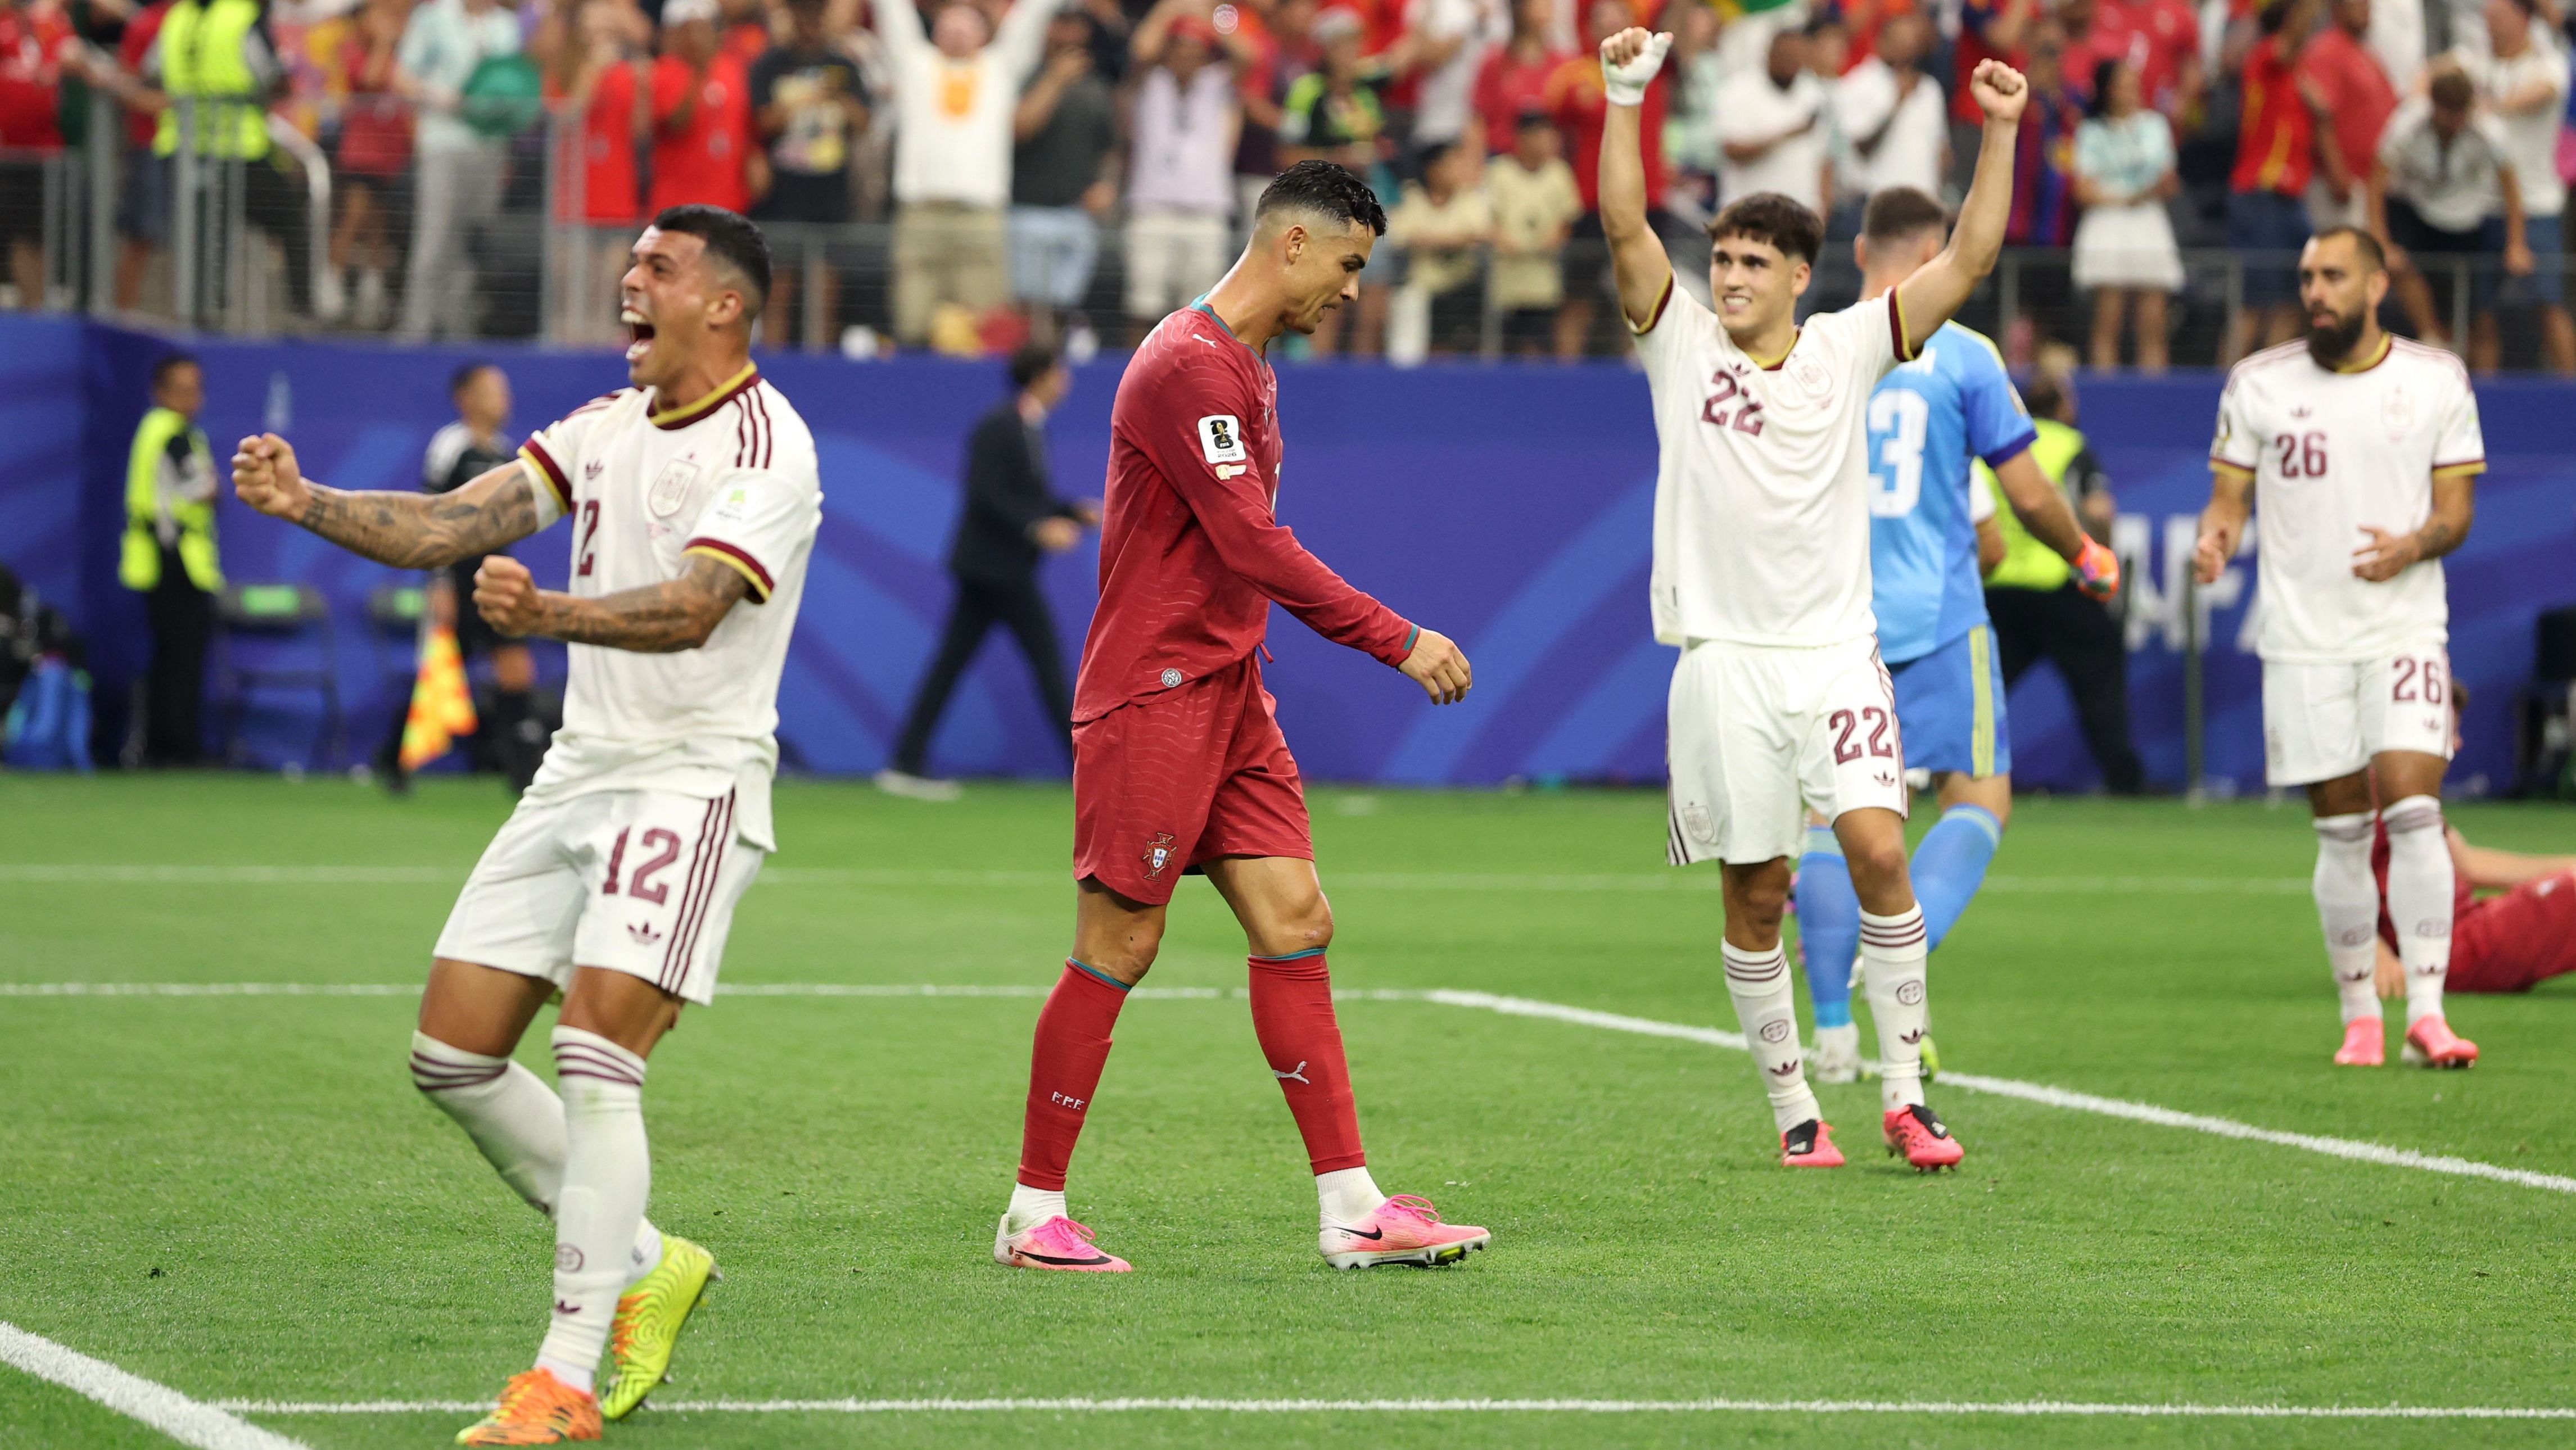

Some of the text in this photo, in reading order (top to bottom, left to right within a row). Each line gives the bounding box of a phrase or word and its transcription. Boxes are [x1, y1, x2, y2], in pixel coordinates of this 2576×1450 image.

[1701, 370, 1764, 436] 22
[2276, 432, 2327, 478] 26
[2392, 657, 2442, 704] 26
[1829, 706, 1893, 765] 22
[602, 826, 681, 906] 12
